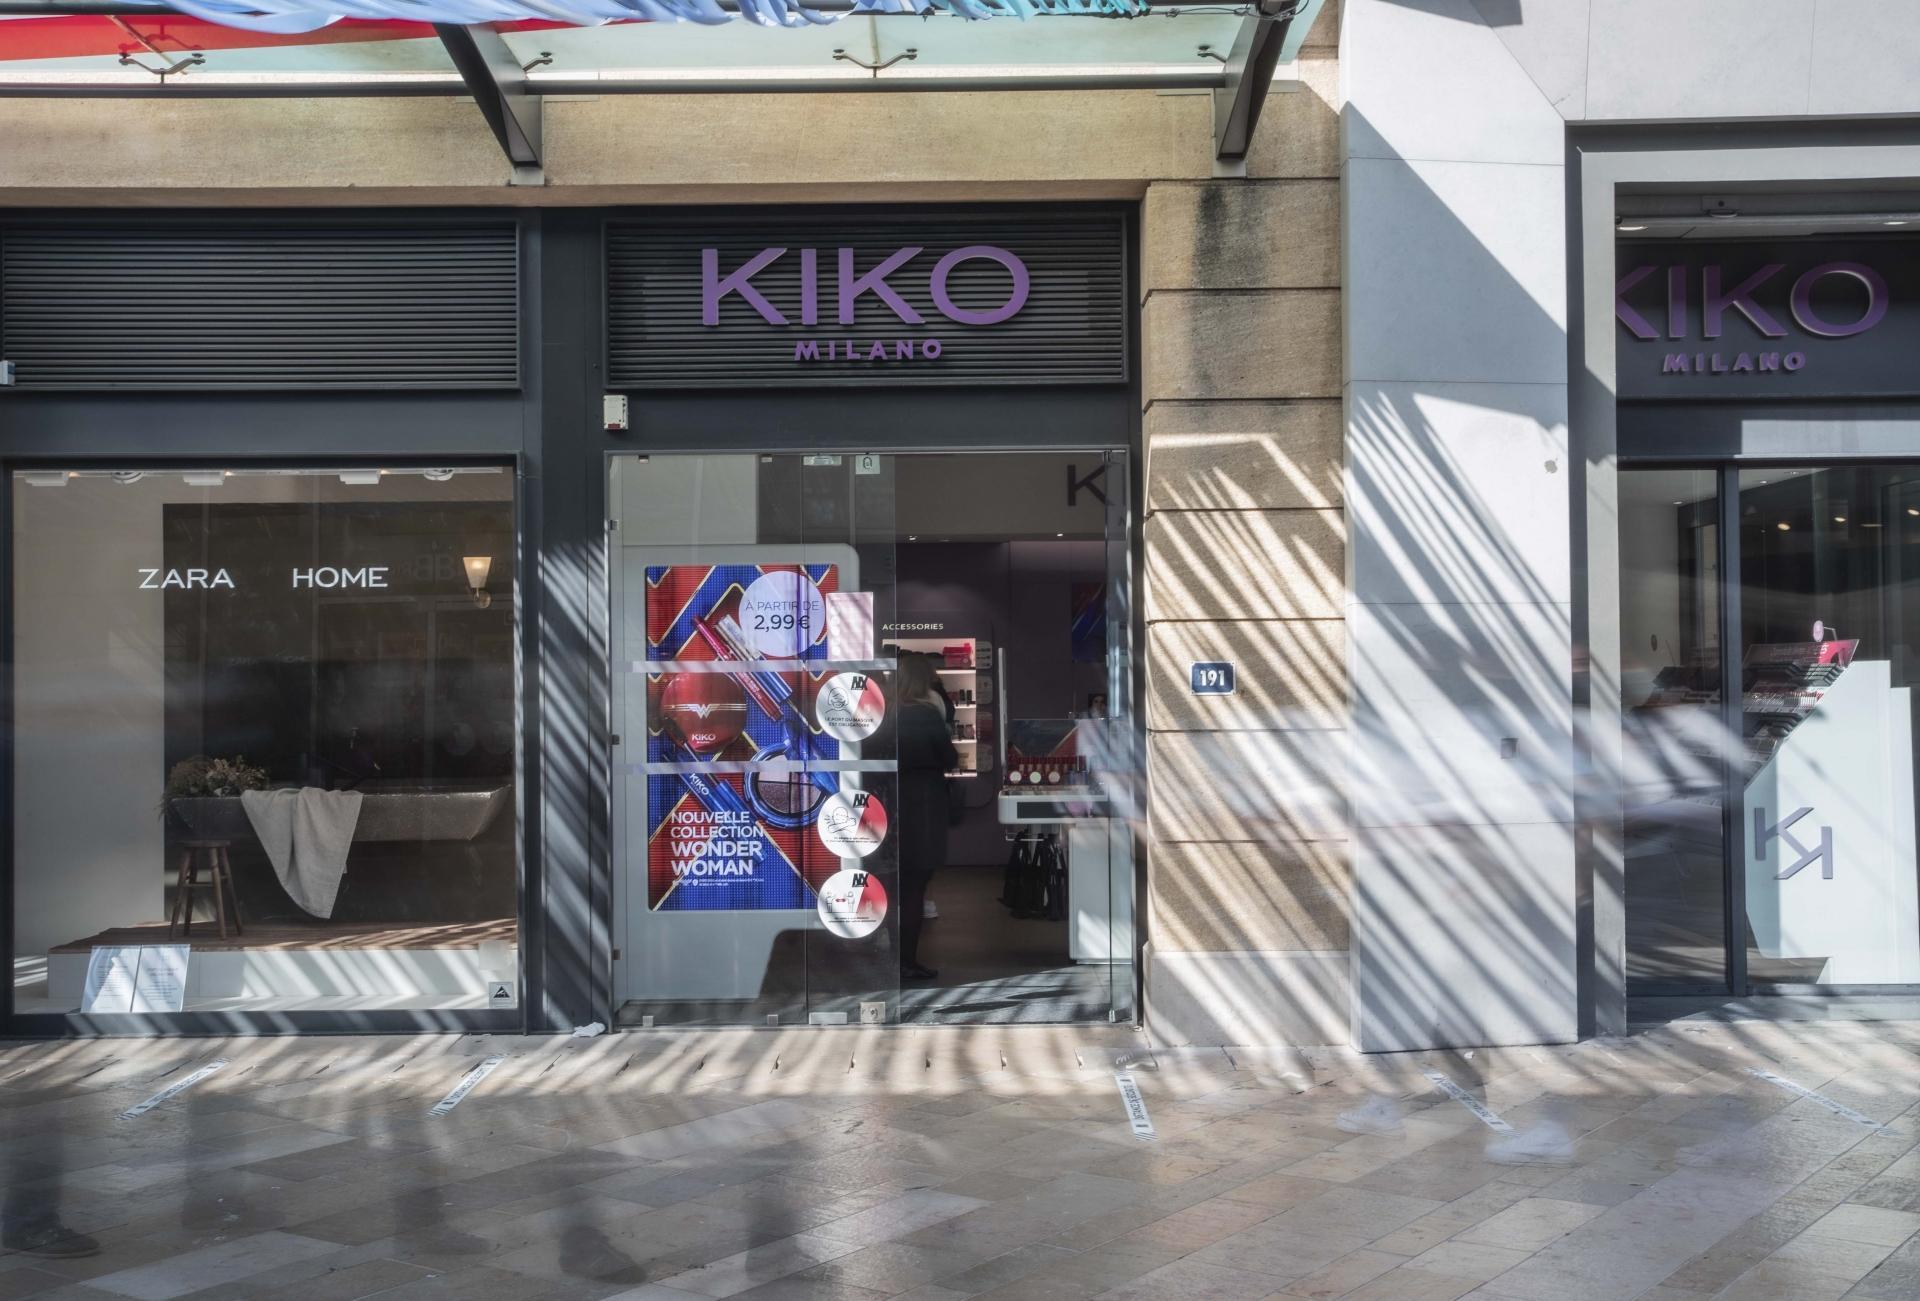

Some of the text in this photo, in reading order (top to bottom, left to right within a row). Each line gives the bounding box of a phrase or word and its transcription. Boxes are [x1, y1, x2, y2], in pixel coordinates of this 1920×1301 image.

[701, 245, 1031, 326] KIKO
[794, 338, 943, 361] MILANO
[1663, 351, 1806, 373] MILANO
[138, 567, 389, 589] ZARA HOME
[757, 601, 799, 611] PARTIR
[803, 601, 820, 611] DE
[882, 623, 944, 631] ACCESSORIES
[1200, 670, 1225, 687] 191
[691, 733, 716, 741] KIKO
[689, 773, 710, 796] KIKO
[671, 811, 750, 824] NOUVELLE
[671, 825, 764, 838] COLLECTION
[671, 841, 763, 857] WONDER
[671, 860, 753, 876] WOMAN
